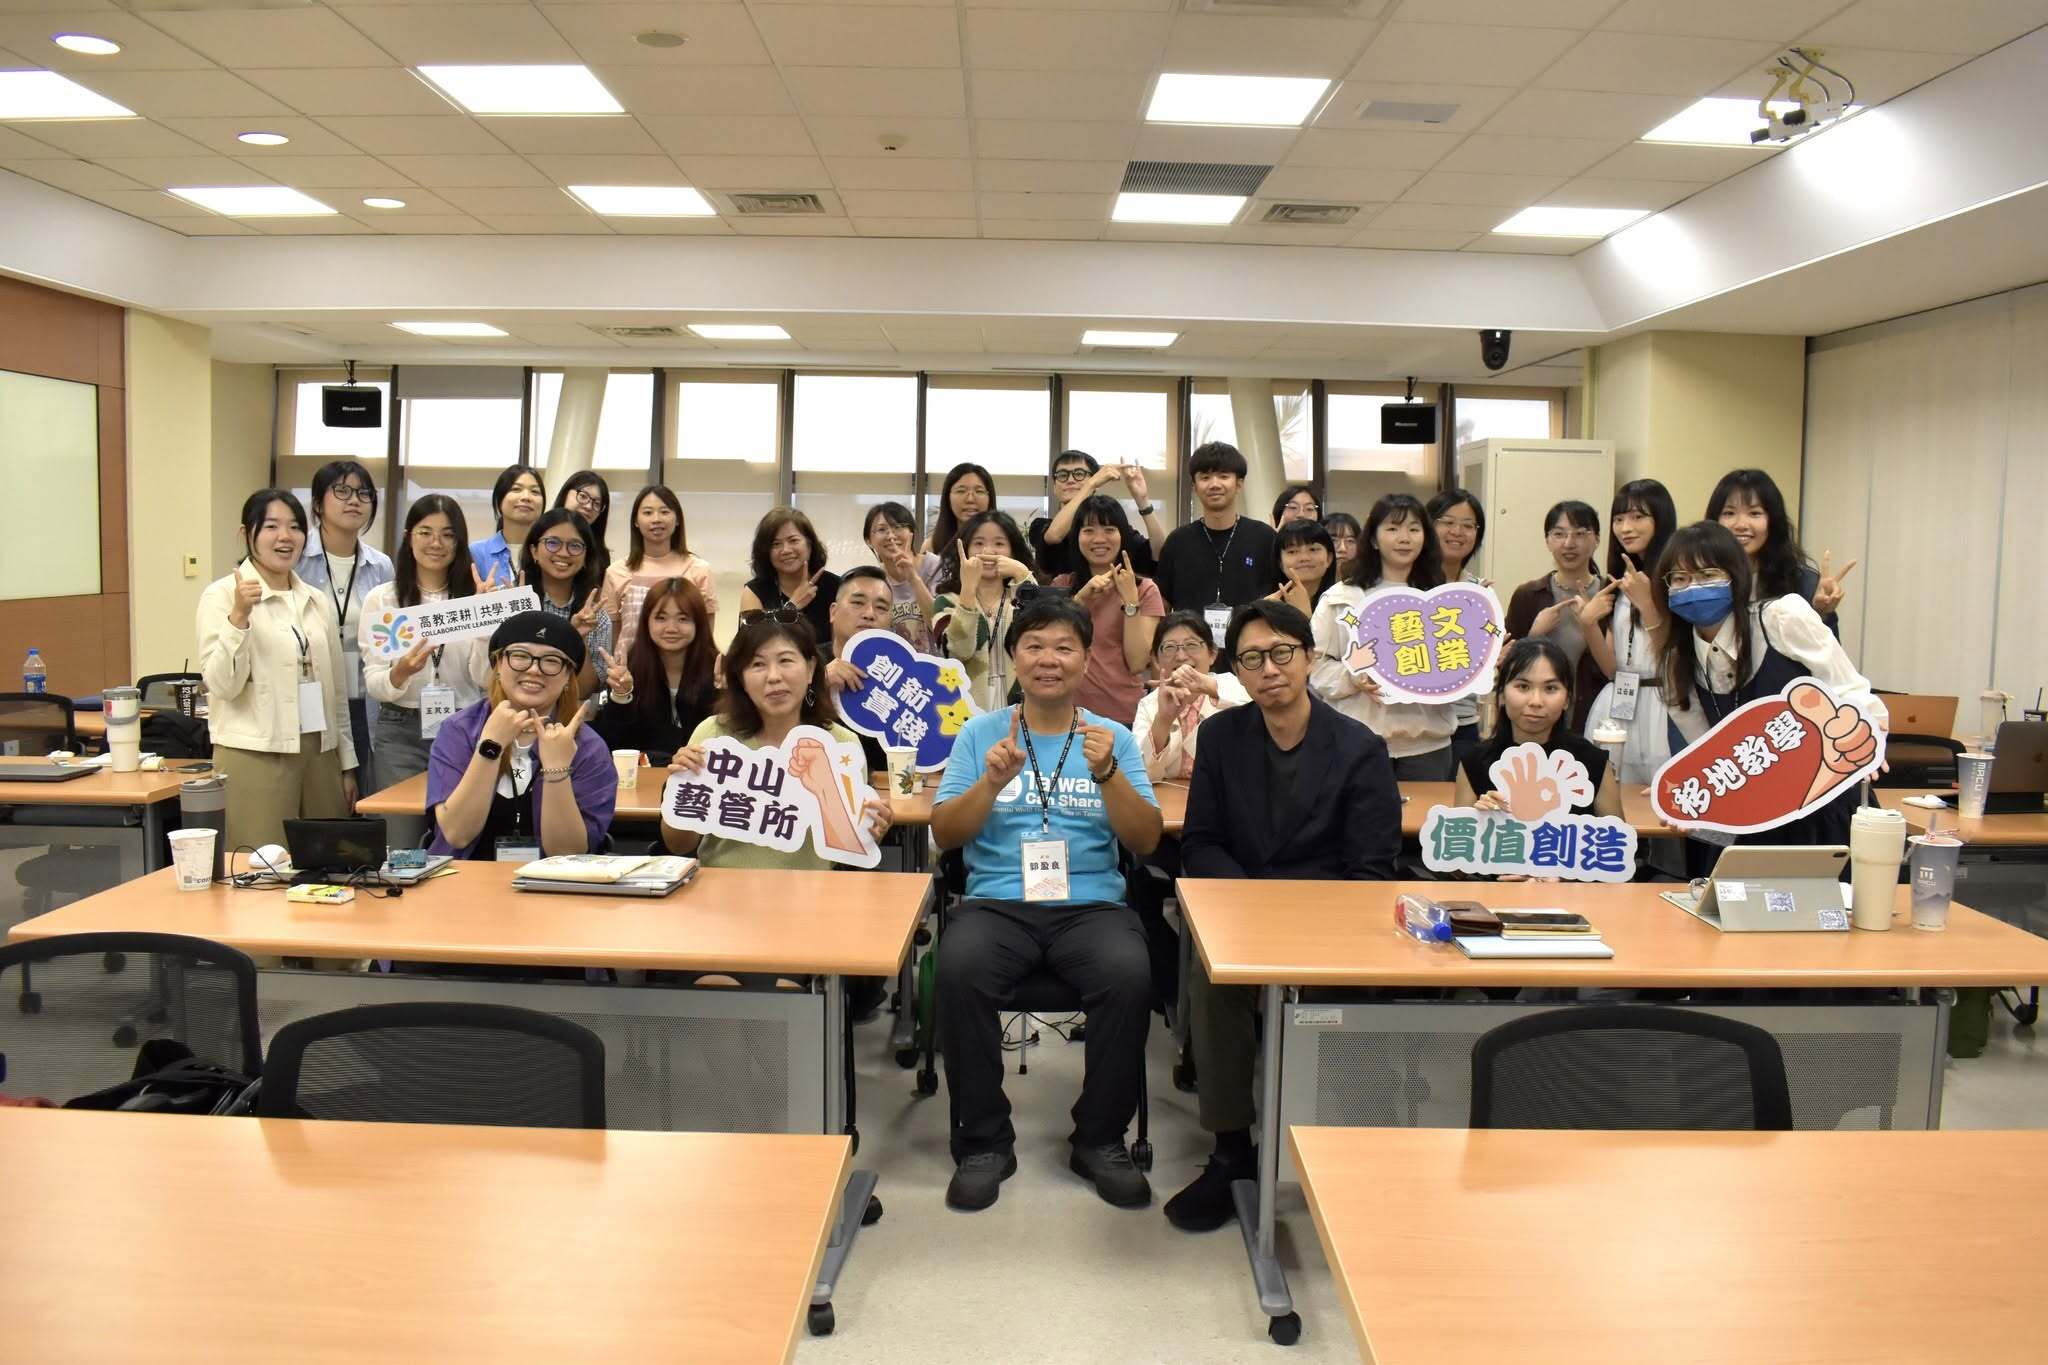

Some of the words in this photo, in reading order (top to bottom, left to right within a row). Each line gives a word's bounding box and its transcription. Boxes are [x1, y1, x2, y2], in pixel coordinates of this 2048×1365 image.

[418, 608, 472, 628] 高教深耕
[421, 623, 471, 637] COLLABORATIVE
[472, 617, 501, 629] LEARNING
[1389, 606, 1466, 644] 藝文
[1394, 637, 1471, 676] 創業
[866, 654, 934, 713] 創新
[861, 686, 928, 746] 實踐
[706, 748, 785, 797] 中山
[1672, 710, 1807, 819] 移地教學
[673, 782, 799, 841] 藝管所
[1025, 792, 1055, 807] Can
[1058, 794, 1102, 809] Share
[1430, 814, 1628, 873] 價值創造
